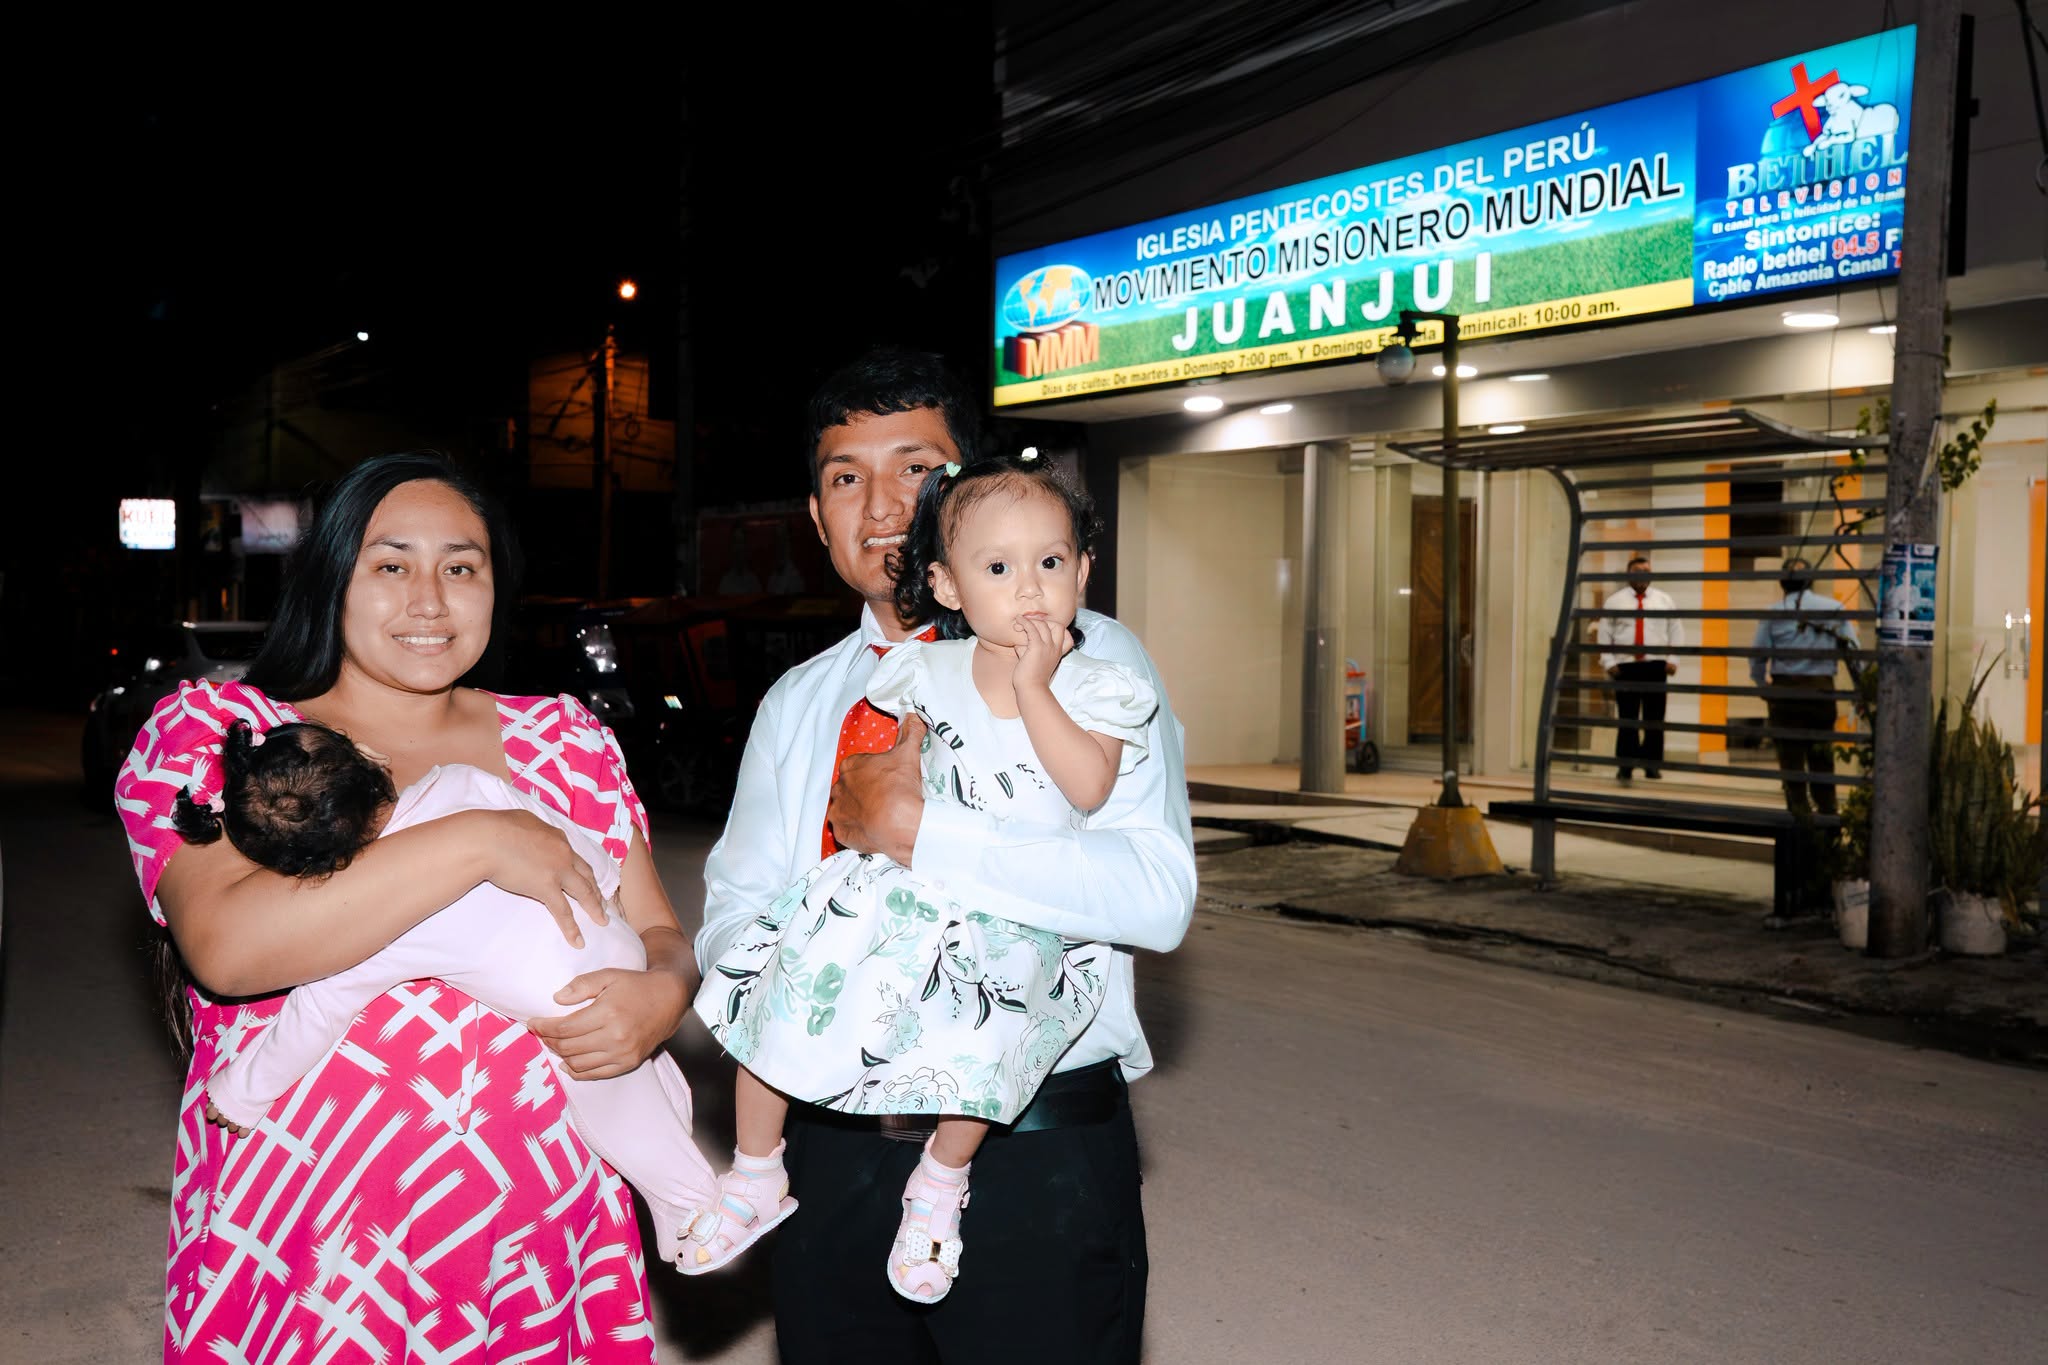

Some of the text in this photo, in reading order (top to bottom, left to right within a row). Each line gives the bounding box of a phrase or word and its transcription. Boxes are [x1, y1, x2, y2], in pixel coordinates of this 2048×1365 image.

[1137, 121, 1596, 260] IGLESIA PENTECOSTES DEL PERÚ
[1726, 167, 1903, 218] TELEVISION
[1727, 133, 1908, 200] BETHEL
[1094, 157, 1681, 310] MOVIMIENTO MISIONERO MUNDIAL
[1703, 227, 1903, 280] Radio bethel 94.5 F
[1745, 212, 1881, 250] Sintonice:
[1172, 252, 1491, 352] JUANJUI
[1708, 275, 1751, 297] Cable
[1756, 264, 1834, 289] Amazonia
[1838, 253, 1888, 278] Canal
[1018, 323, 1100, 379] MMM
[1183, 358, 1235, 376] Domingo
[1240, 351, 1265, 368] 7:00
[1298, 345, 1307, 359] Y
[1313, 337, 1373, 358] Domingo
[1460, 312, 1528, 336] minical:
[1535, 301, 1582, 325] 10:00
[1588, 299, 1621, 316] am.
